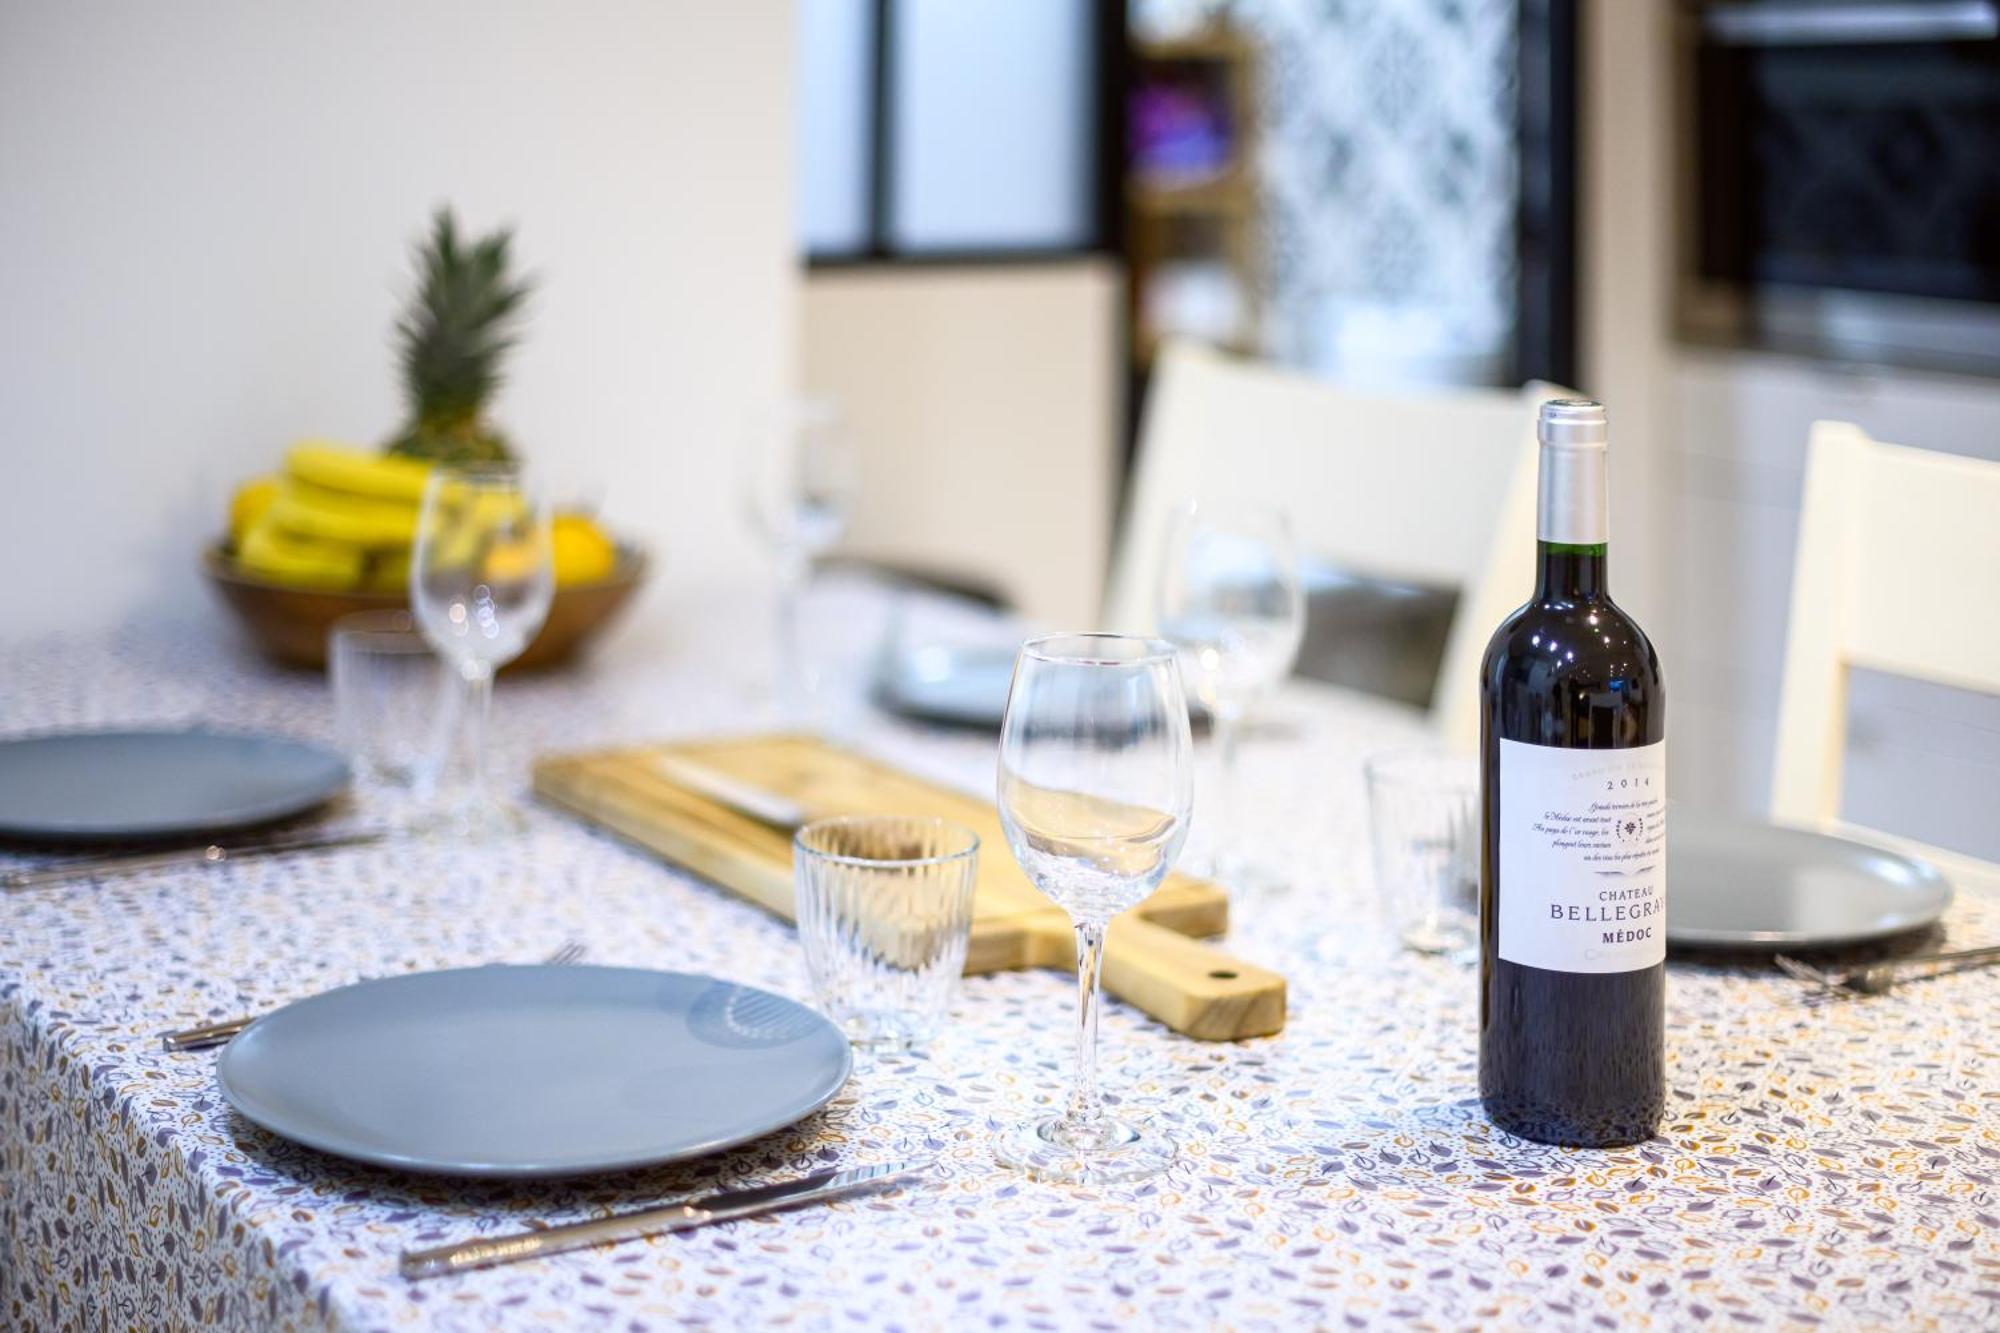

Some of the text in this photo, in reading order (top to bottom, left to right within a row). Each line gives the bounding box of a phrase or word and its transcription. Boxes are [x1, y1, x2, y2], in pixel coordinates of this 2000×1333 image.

[1607, 777, 1649, 790] 2014
[1599, 885, 1654, 901] CHATEAU
[1602, 927, 1652, 944] MÉDOC
